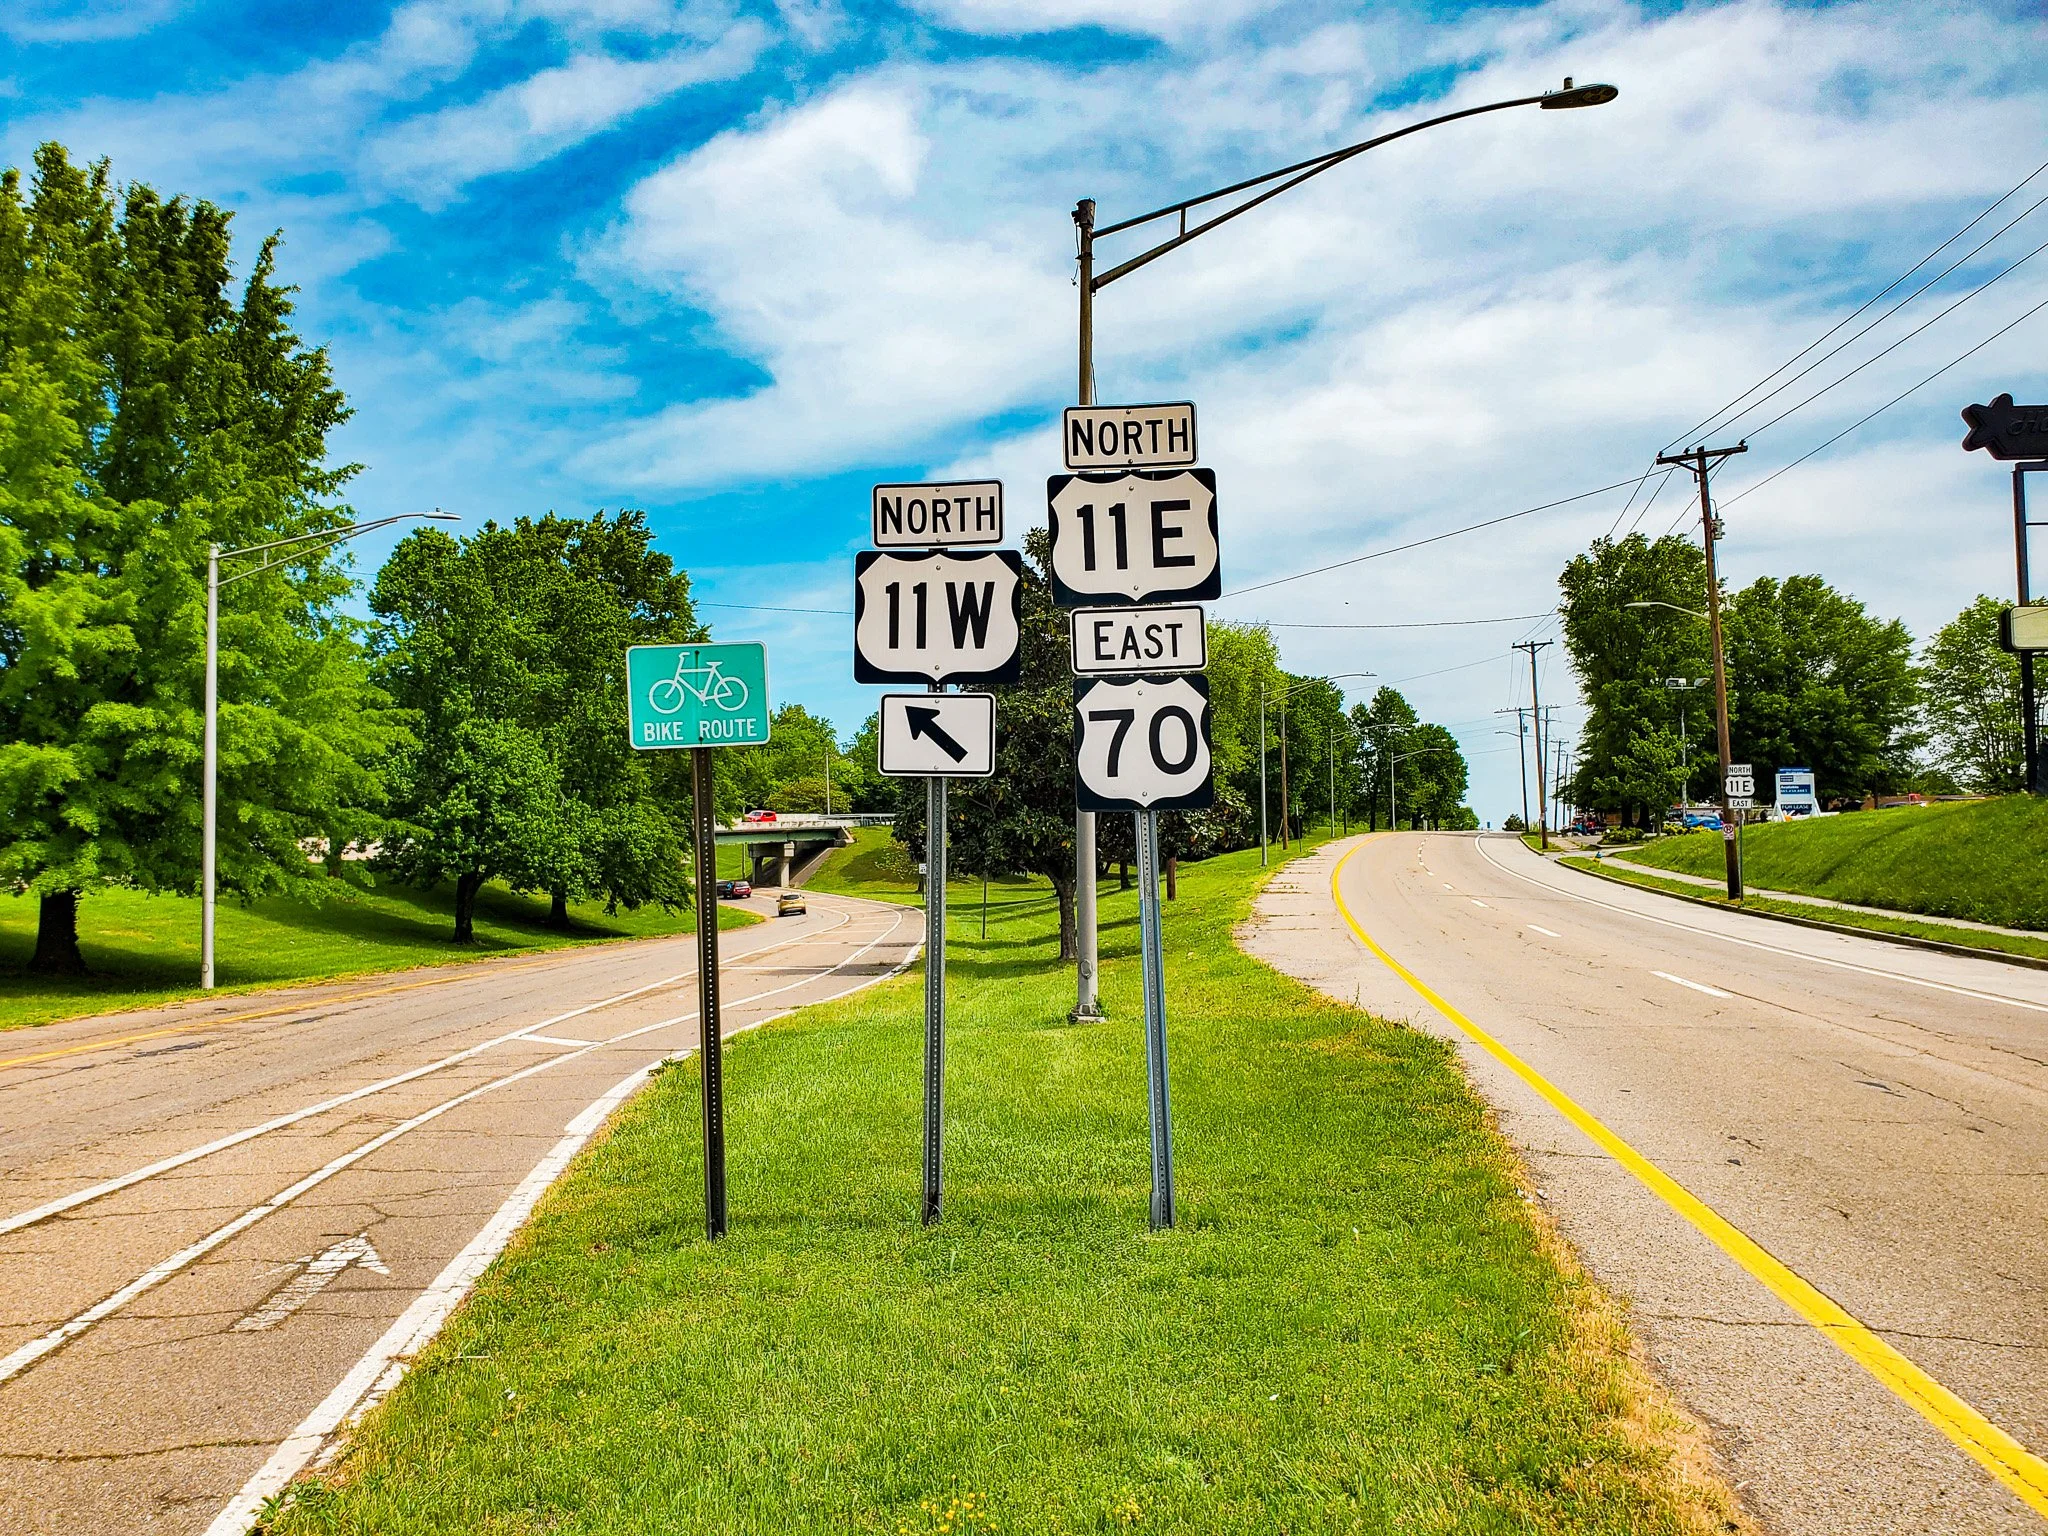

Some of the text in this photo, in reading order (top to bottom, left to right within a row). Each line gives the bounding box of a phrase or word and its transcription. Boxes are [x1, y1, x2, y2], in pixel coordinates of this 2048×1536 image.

[1071, 417, 1189, 457] NORTH
[880, 496, 996, 535] NORTH
[1076, 499, 1196, 572] 11E
[885, 581, 996, 650] 11W
[1093, 620, 1183, 661] EAST
[643, 717, 758, 742] BIKE ROUTE
[1088, 705, 1198, 778] 70
[1729, 766, 1751, 774] NORTH
[1729, 780, 1751, 793] 11E
[1732, 799, 1748, 807] EAST
